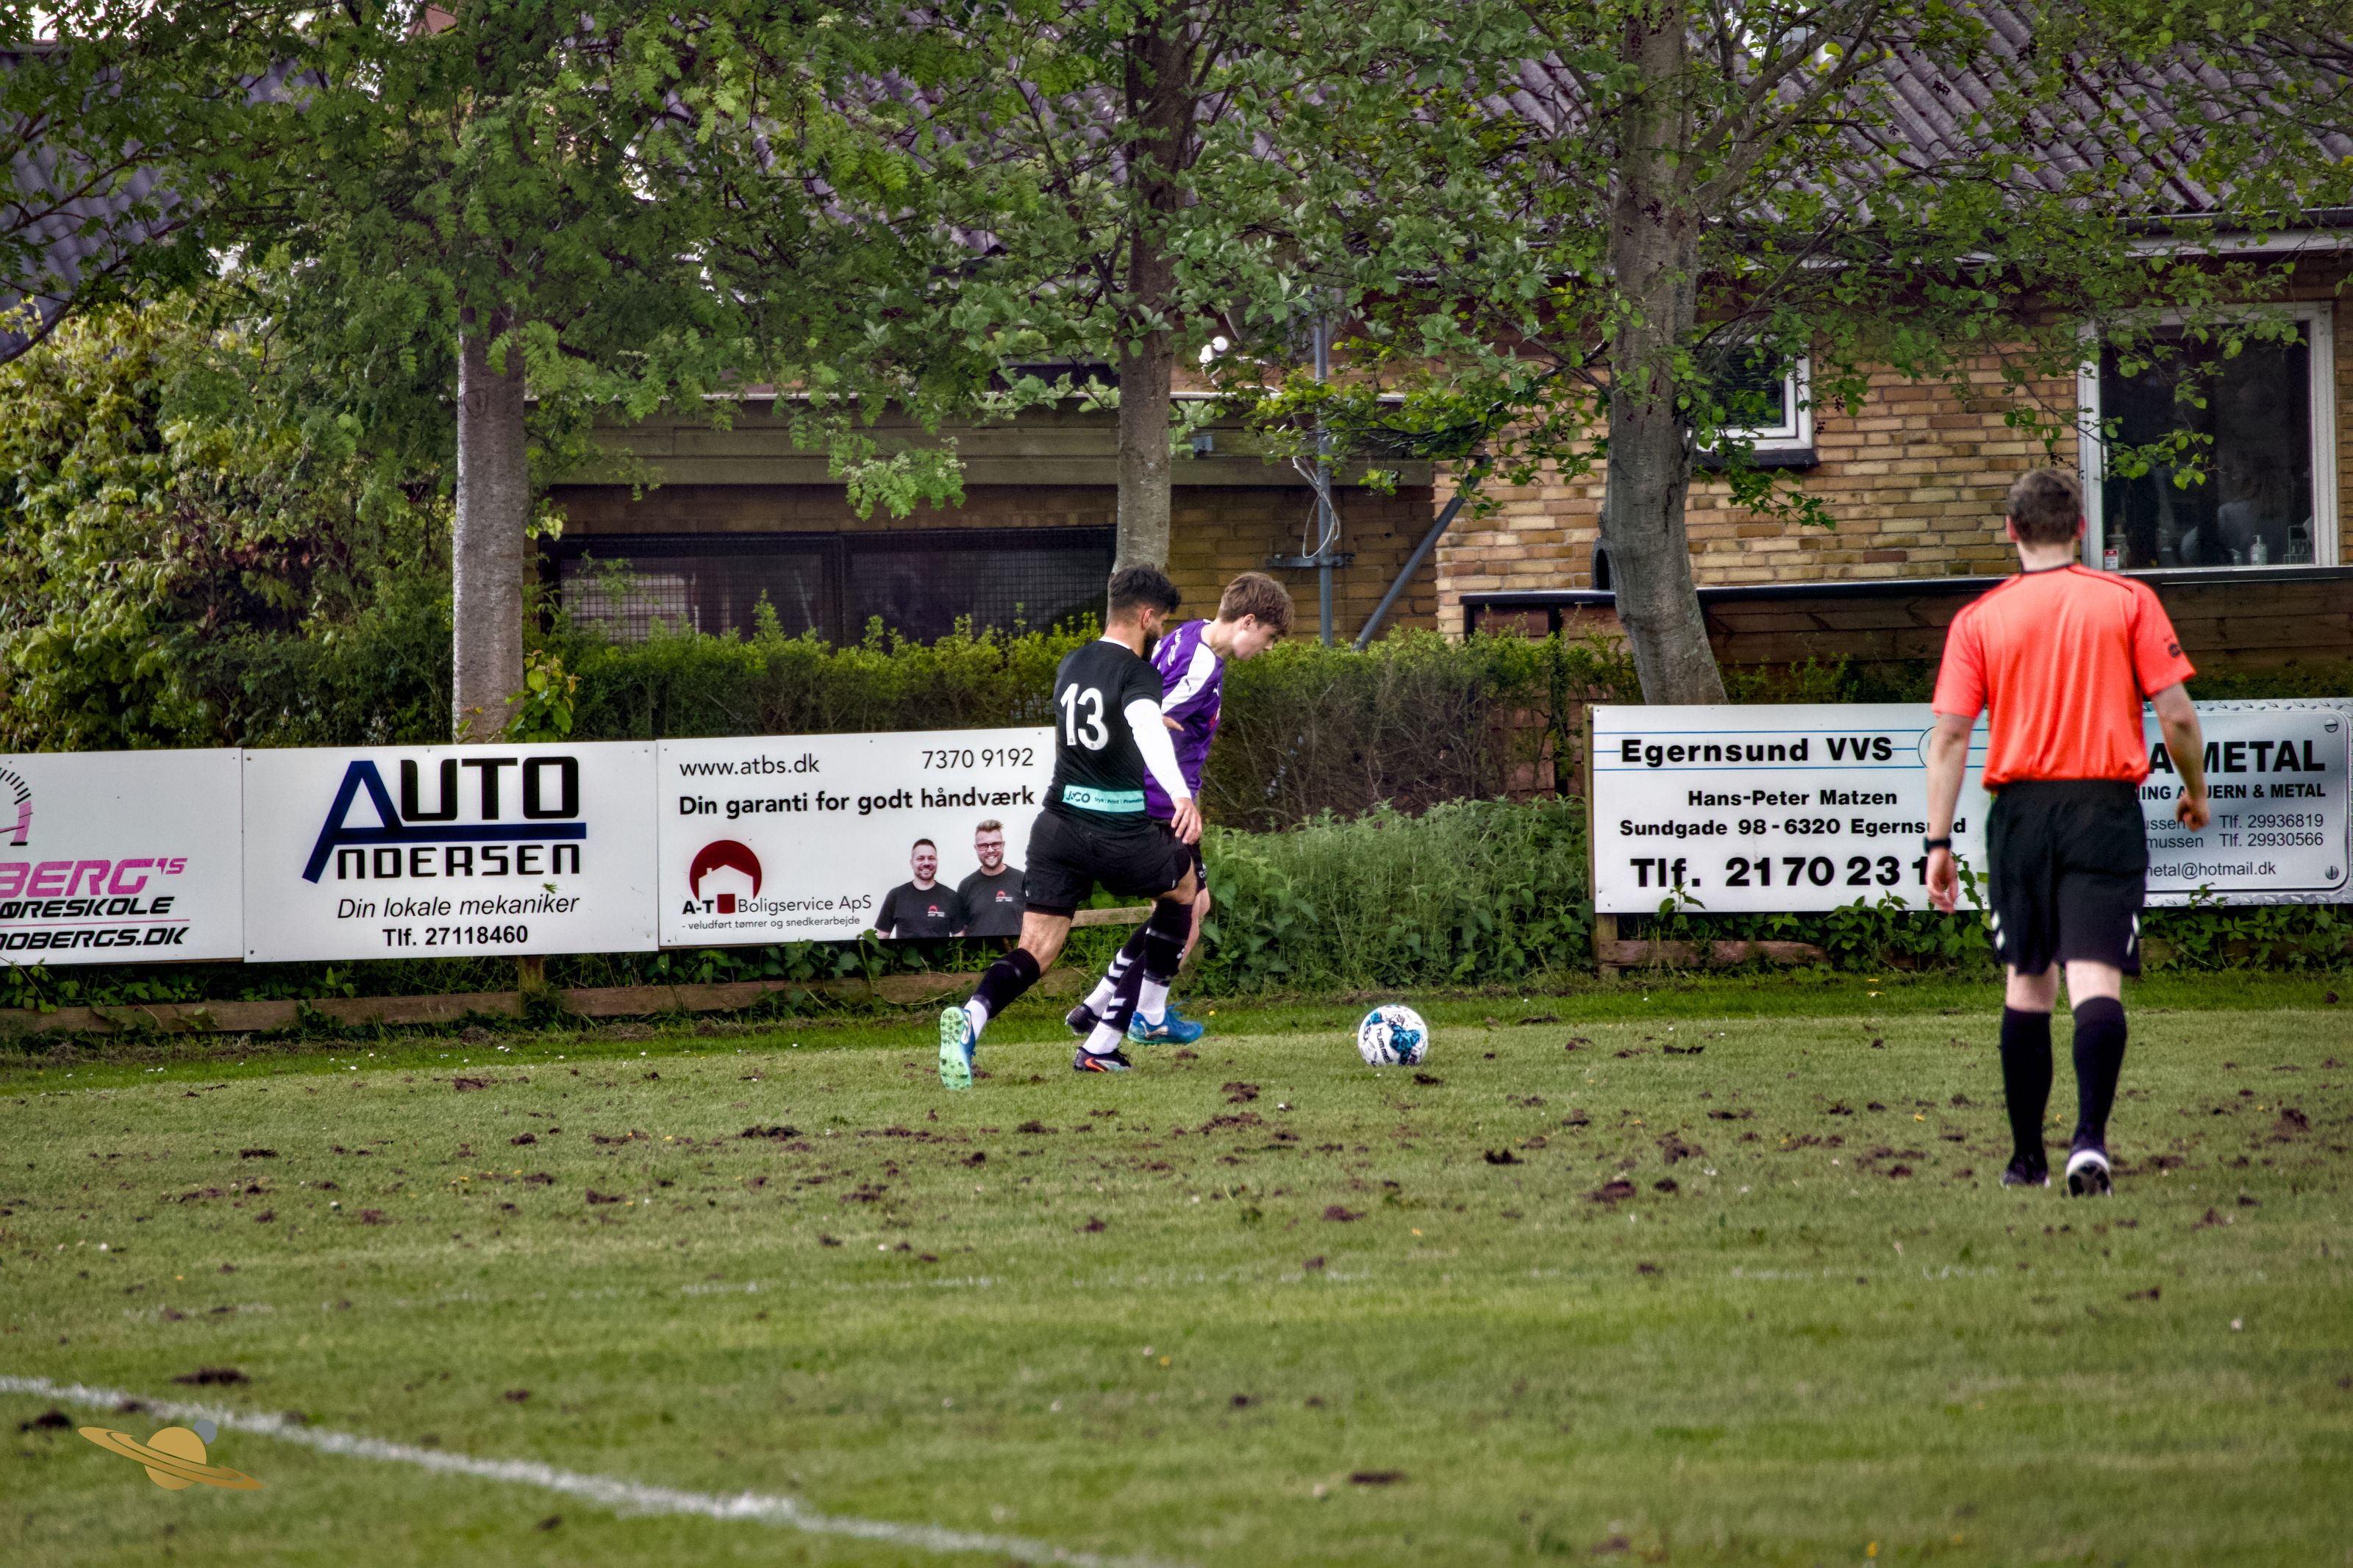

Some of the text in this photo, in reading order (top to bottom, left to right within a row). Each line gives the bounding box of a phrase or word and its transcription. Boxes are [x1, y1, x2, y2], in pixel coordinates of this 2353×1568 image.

[1060, 683, 1108, 750] 13
[921, 748, 1034, 770] 7370 9192
[1621, 737, 1893, 767] Egernsund VVS
[679, 753, 820, 776] www.atbs.dk
[1689, 789, 1897, 806] Hans-Peter Matzen
[2252, 784, 2265, 798] &
[2271, 783, 2326, 798] METAL
[679, 785, 1035, 820] Din garanti for godt håndværk
[302, 756, 579, 884] AUTO
[1620, 819, 1728, 840] Sundgade
[1738, 819, 1766, 835] 98
[1785, 818, 1841, 835] 6320
[1851, 817, 1966, 837] Egernsd
[2218, 815, 2242, 829] Tlf.
[2247, 813, 2324, 828] 29936819
[2147, 831, 2324, 848] mussen Tlf. 29930566
[0, 858, 188, 898] BERG'S
[1629, 856, 1702, 887] Tlf.
[1726, 857, 1771, 887] 21
[1782, 856, 1835, 887] 70
[0, 896, 175, 919] ØRESKOLE
[338, 894, 580, 919] Din lokale mekaniker
[682, 895, 871, 916] A-T Boligservice ApS
[688, 919, 732, 930] veludført
[735, 919, 768, 929] tømrer
[771, 920, 783, 929] og
[786, 916, 860, 928] snedkerarbejde
[382, 925, 528, 947] Tlf. 27118460
[1377, 1028, 1393, 1063] hummel
